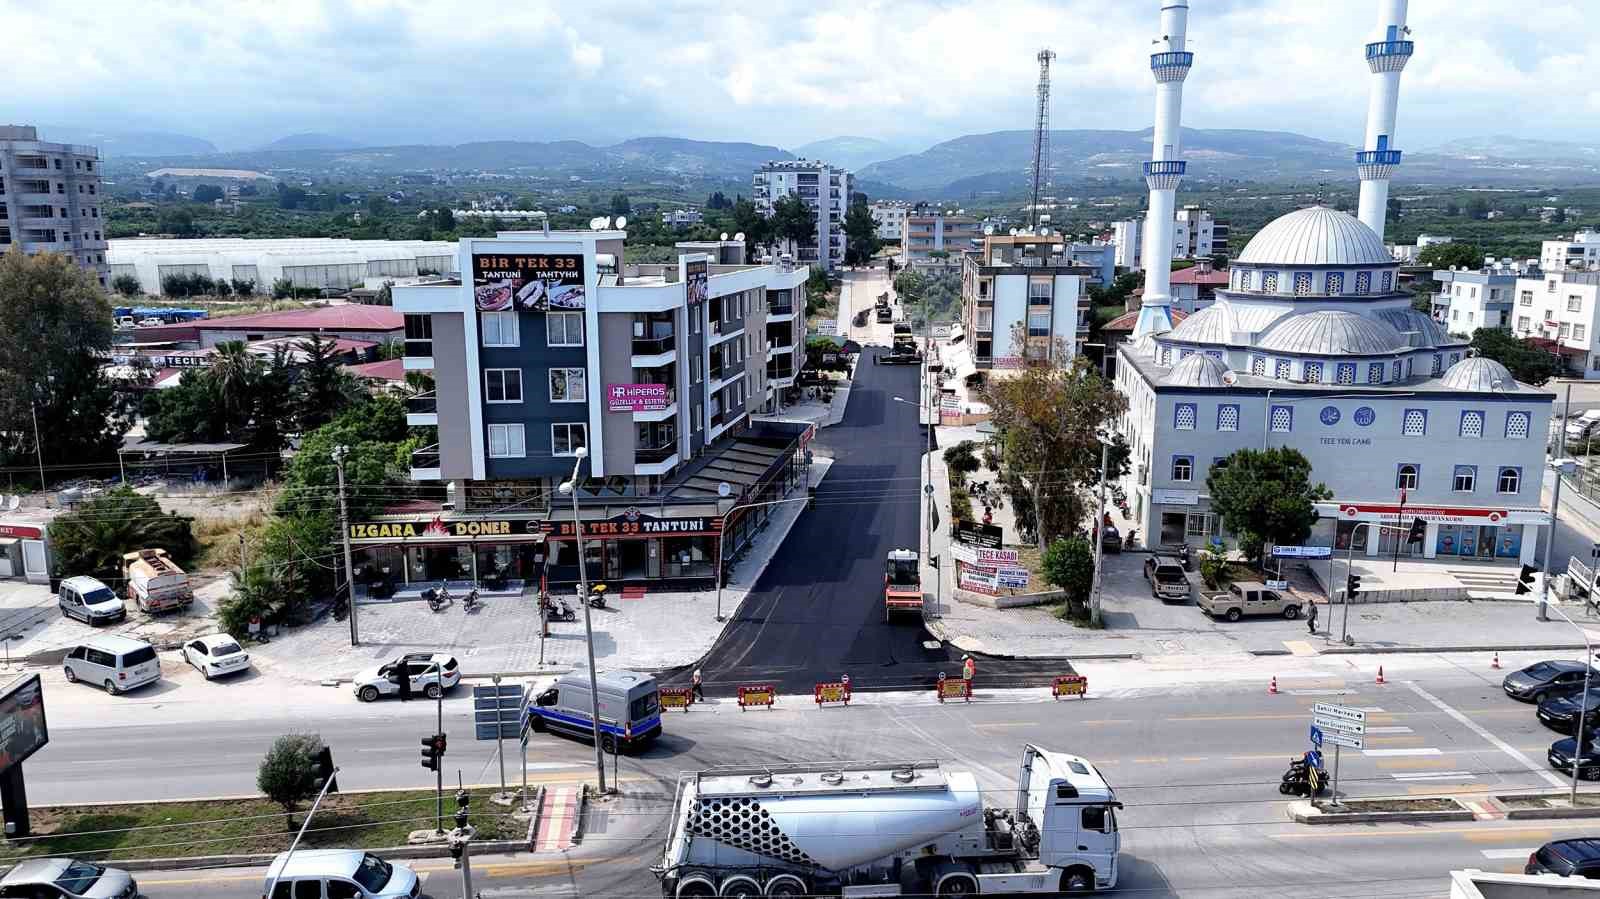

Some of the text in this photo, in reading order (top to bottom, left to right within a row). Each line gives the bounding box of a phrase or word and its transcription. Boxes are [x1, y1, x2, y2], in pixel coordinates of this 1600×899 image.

[479, 256, 576, 269] BİR TEK 33
[482, 269, 521, 279] TANTUNİ
[626, 386, 665, 397] HİPEROS
[351, 519, 511, 539] IZGARA DÖNER
[560, 518, 704, 535] BİR TEK 33 TANTUNİ
[979, 549, 995, 559] TECE
[995, 550, 1017, 561] KASABI
